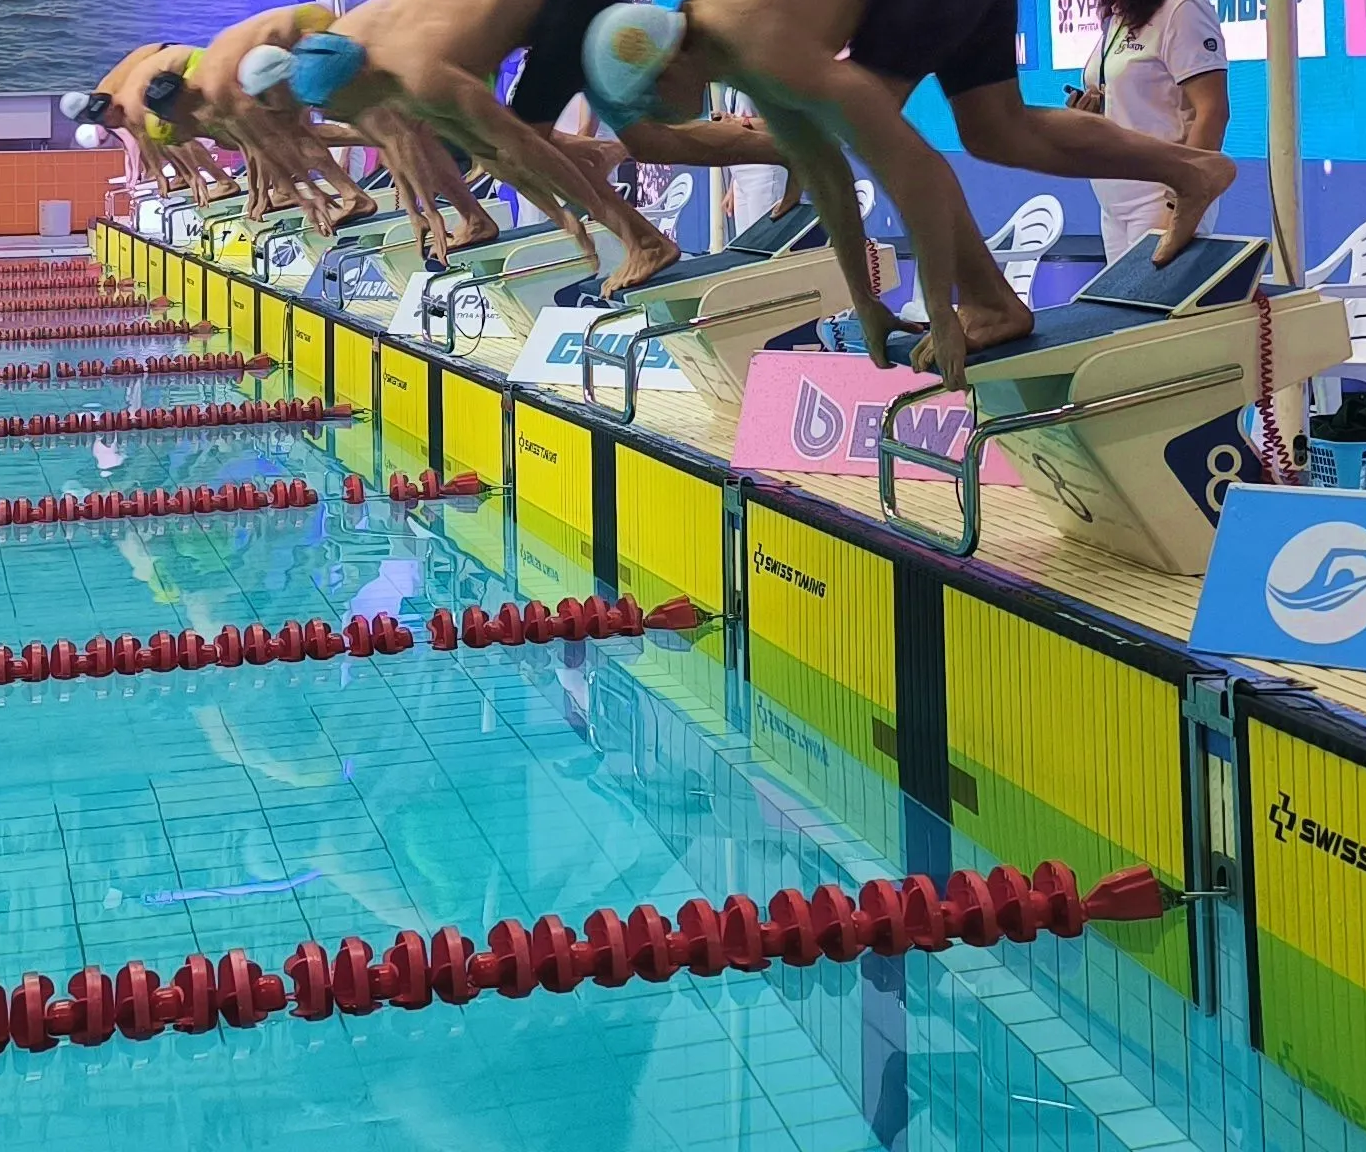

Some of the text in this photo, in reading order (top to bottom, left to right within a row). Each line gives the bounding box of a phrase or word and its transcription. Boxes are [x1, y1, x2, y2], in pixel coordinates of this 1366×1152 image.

[1032, 453, 1093, 523] 8
[1206, 444, 1245, 512] 8
[764, 556, 826, 598] SWISS TIMING
